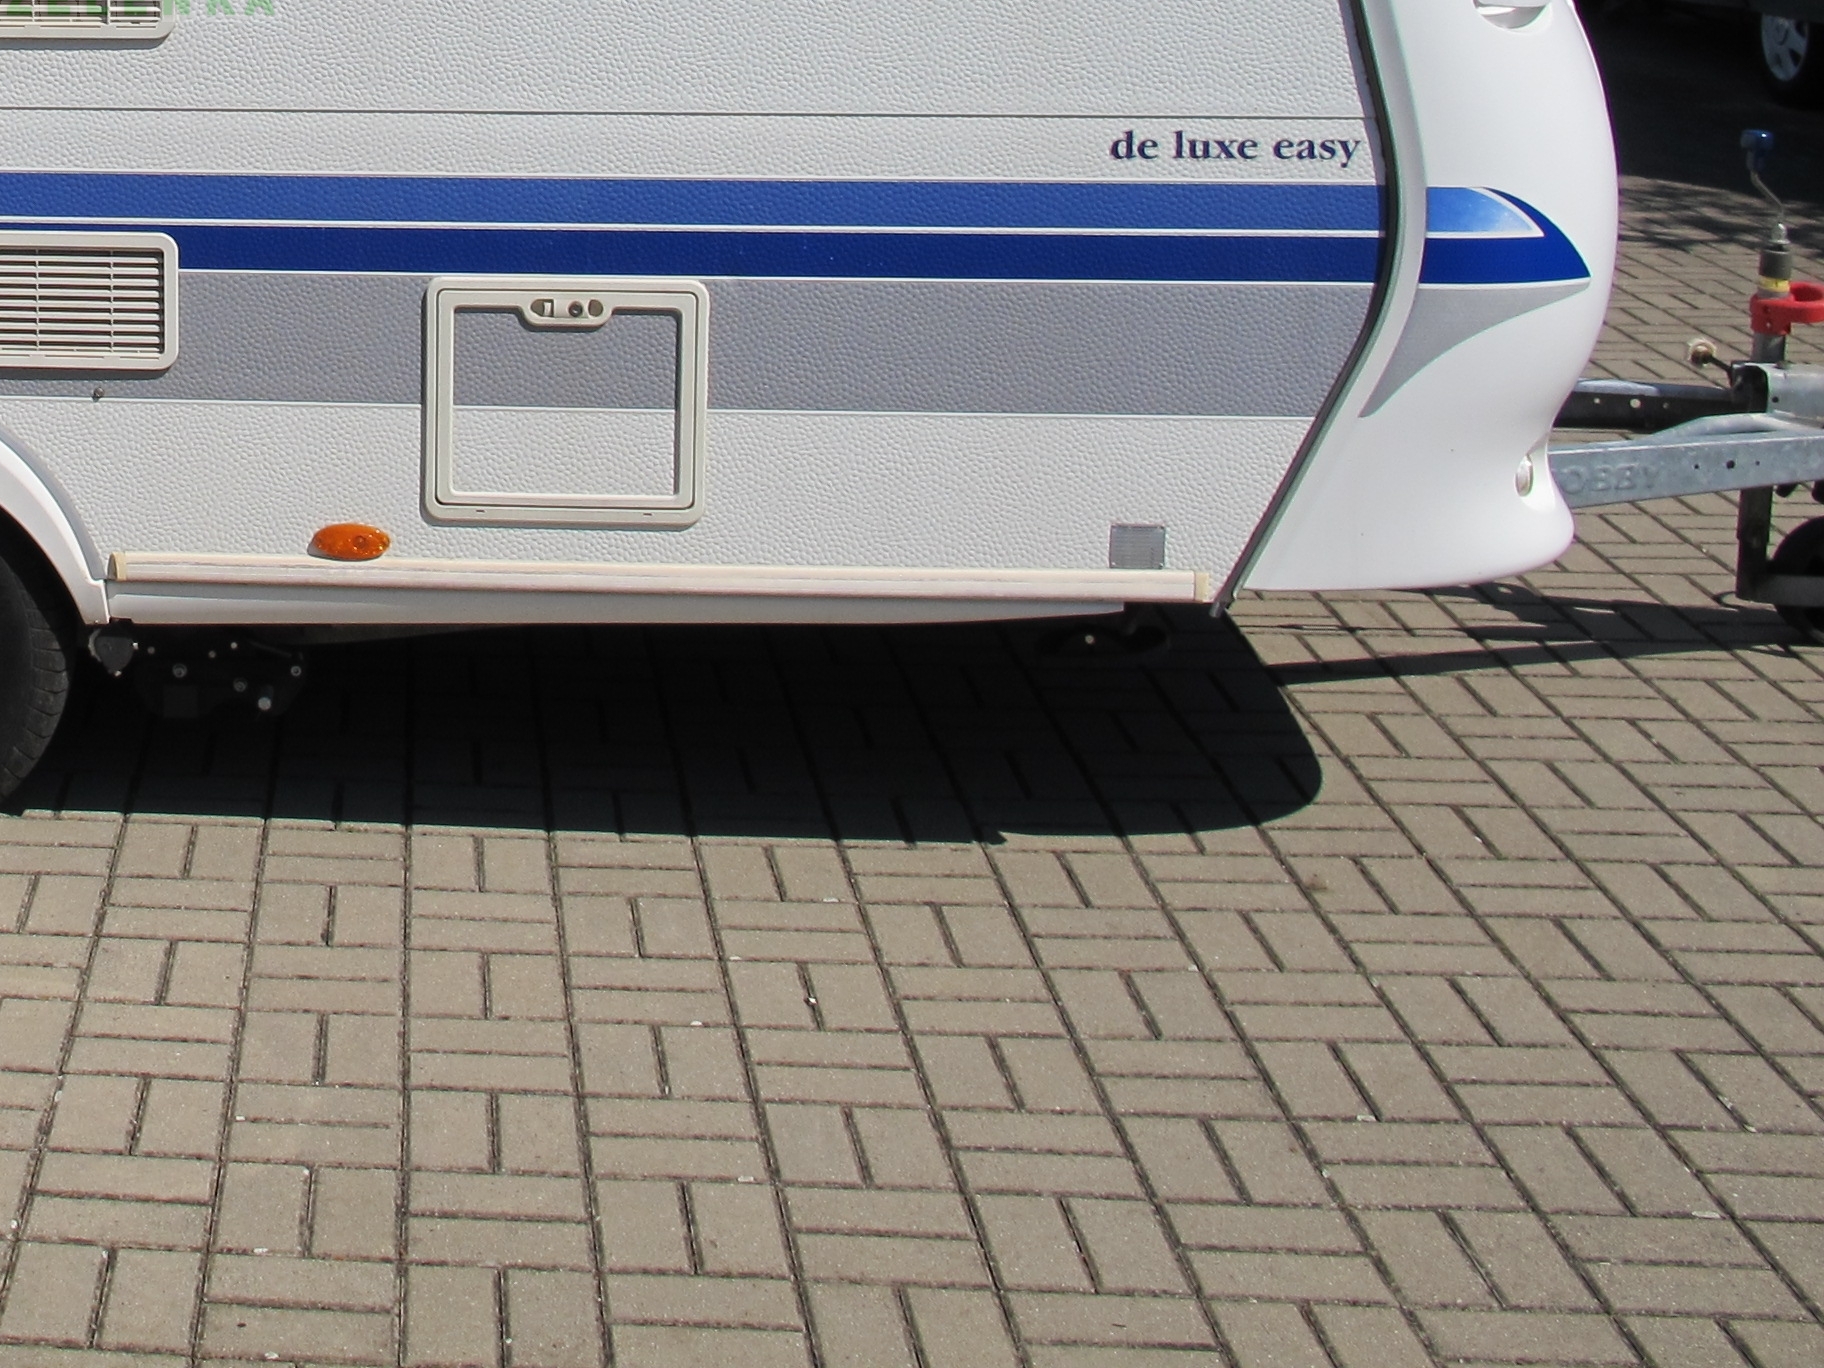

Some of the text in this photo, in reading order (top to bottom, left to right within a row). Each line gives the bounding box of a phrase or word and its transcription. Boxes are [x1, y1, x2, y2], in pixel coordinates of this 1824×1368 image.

[1110, 130, 1361, 168] de luxe easy
